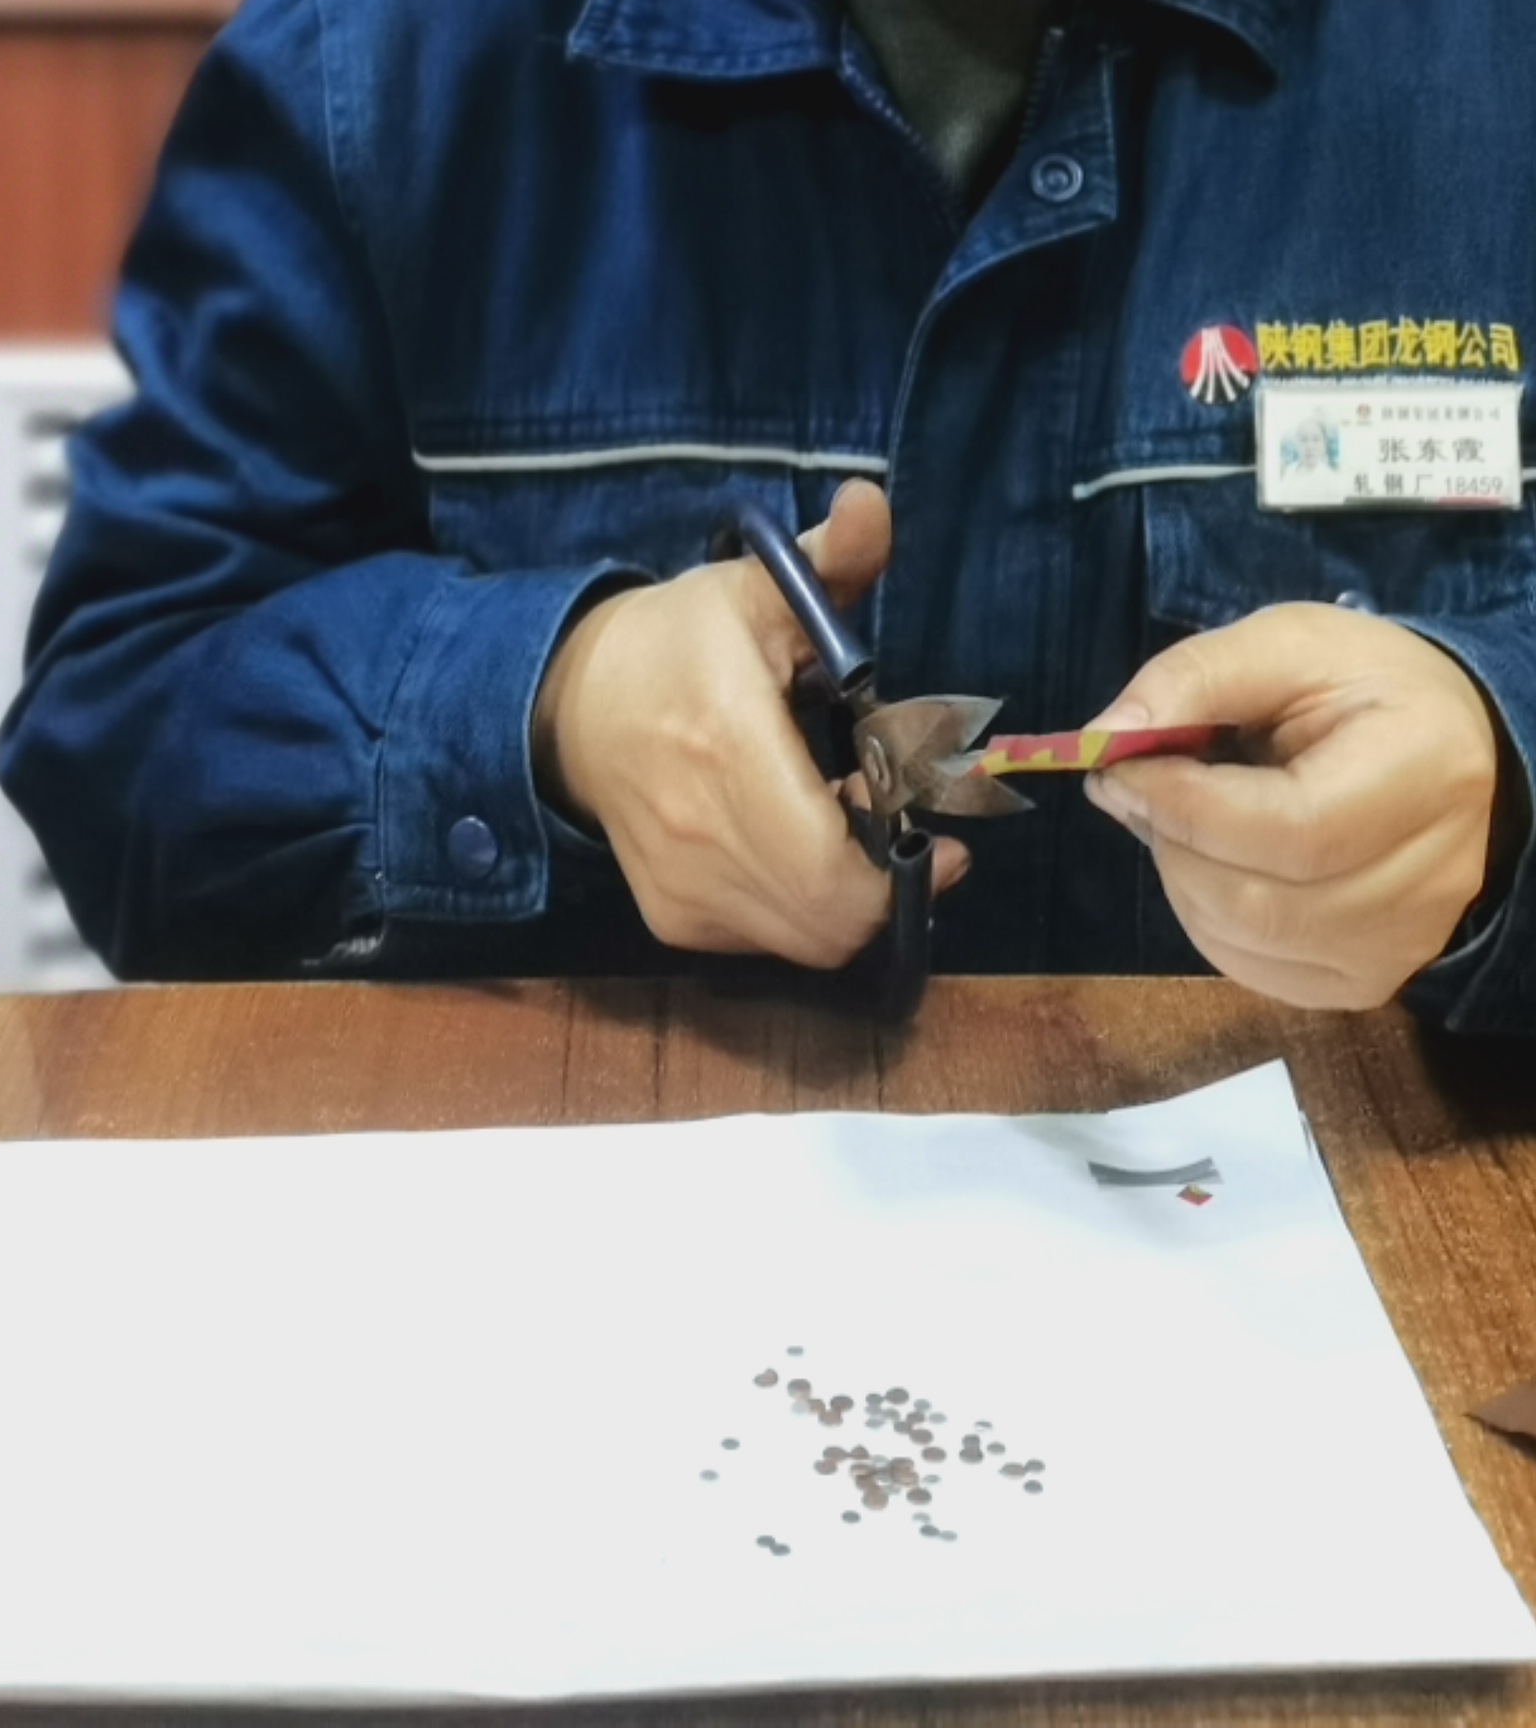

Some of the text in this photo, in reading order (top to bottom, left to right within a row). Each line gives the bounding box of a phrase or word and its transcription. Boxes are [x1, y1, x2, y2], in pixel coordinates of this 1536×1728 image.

[1257, 316, 1519, 372] 陕钢集团龙钢公司
[1377, 437, 1485, 464] 张东霞
